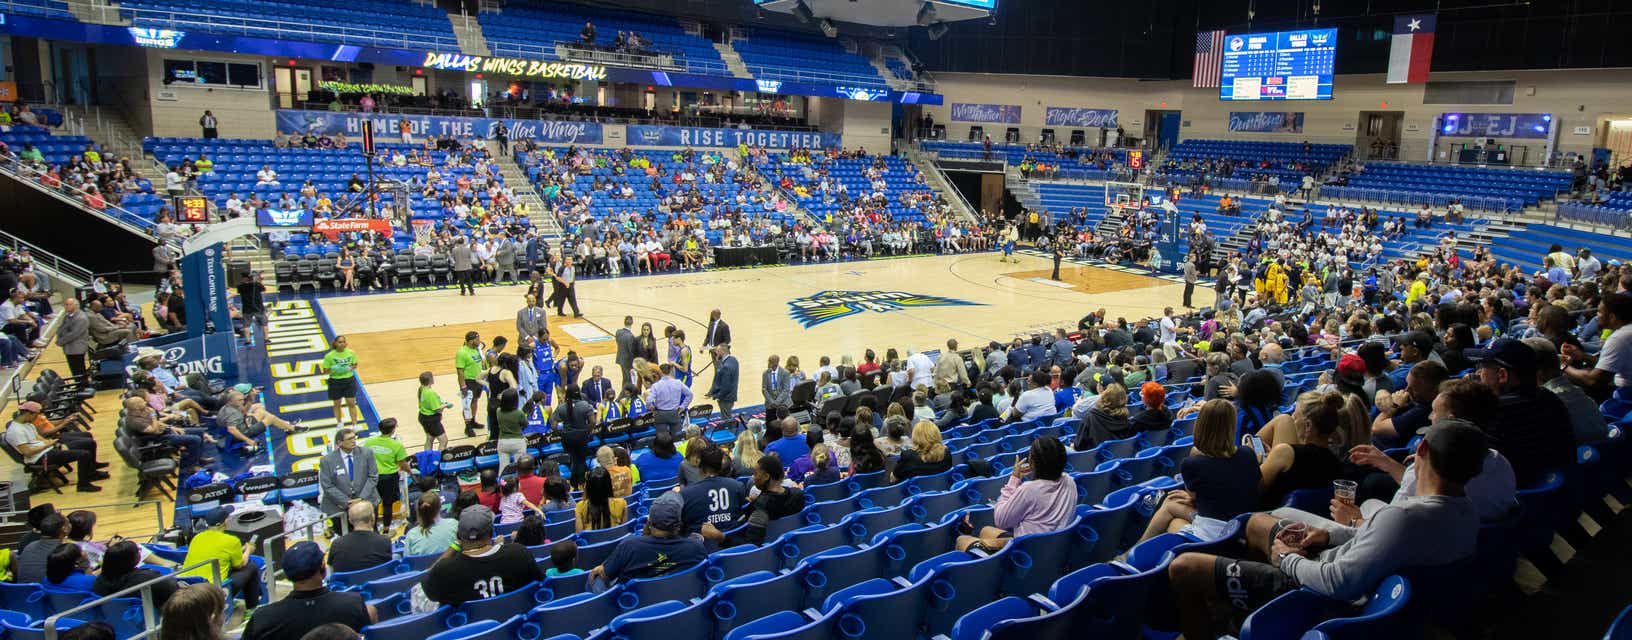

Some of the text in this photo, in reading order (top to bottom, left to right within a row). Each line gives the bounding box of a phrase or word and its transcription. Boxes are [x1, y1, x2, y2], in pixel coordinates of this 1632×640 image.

[423, 52, 607, 80] DALLAS WINGS BASKETBALL
[347, 118, 398, 135] HME
[440, 120, 474, 136] THE
[486, 120, 537, 141] Dllas
[541, 121, 586, 142] Wings
[680, 129, 822, 150] RISE TOGETHER
[187, 208, 201, 219] 15
[203, 487, 228, 500] AT&T
[708, 487, 730, 512] 30
[707, 512, 732, 524] STEVENS
[473, 575, 504, 600] 30
